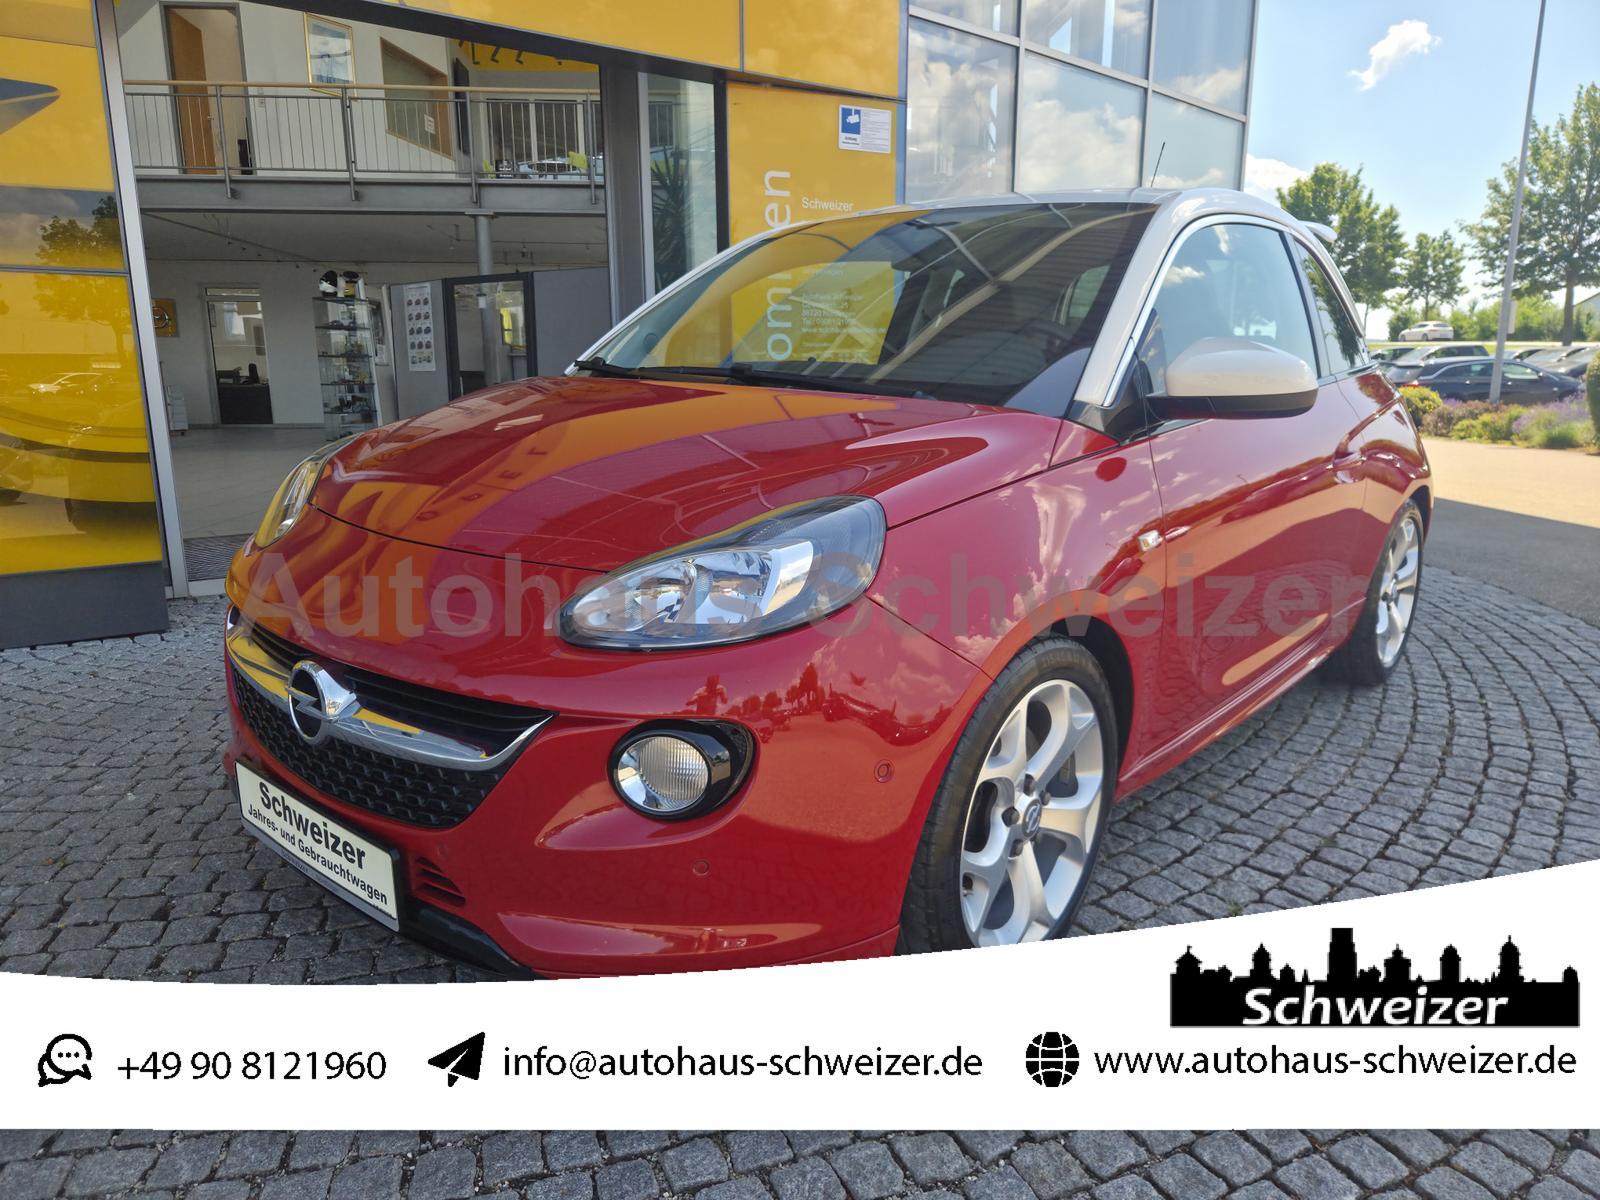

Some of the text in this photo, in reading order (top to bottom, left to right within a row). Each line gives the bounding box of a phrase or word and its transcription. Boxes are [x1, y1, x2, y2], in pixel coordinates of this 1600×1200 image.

[801, 197, 854, 212] Schweizer
[248, 804, 278, 832] Jahres-
[280, 828, 296, 846] und
[298, 838, 388, 905] Gebrauchtwagen
[259, 781, 366, 870] Schweizer
